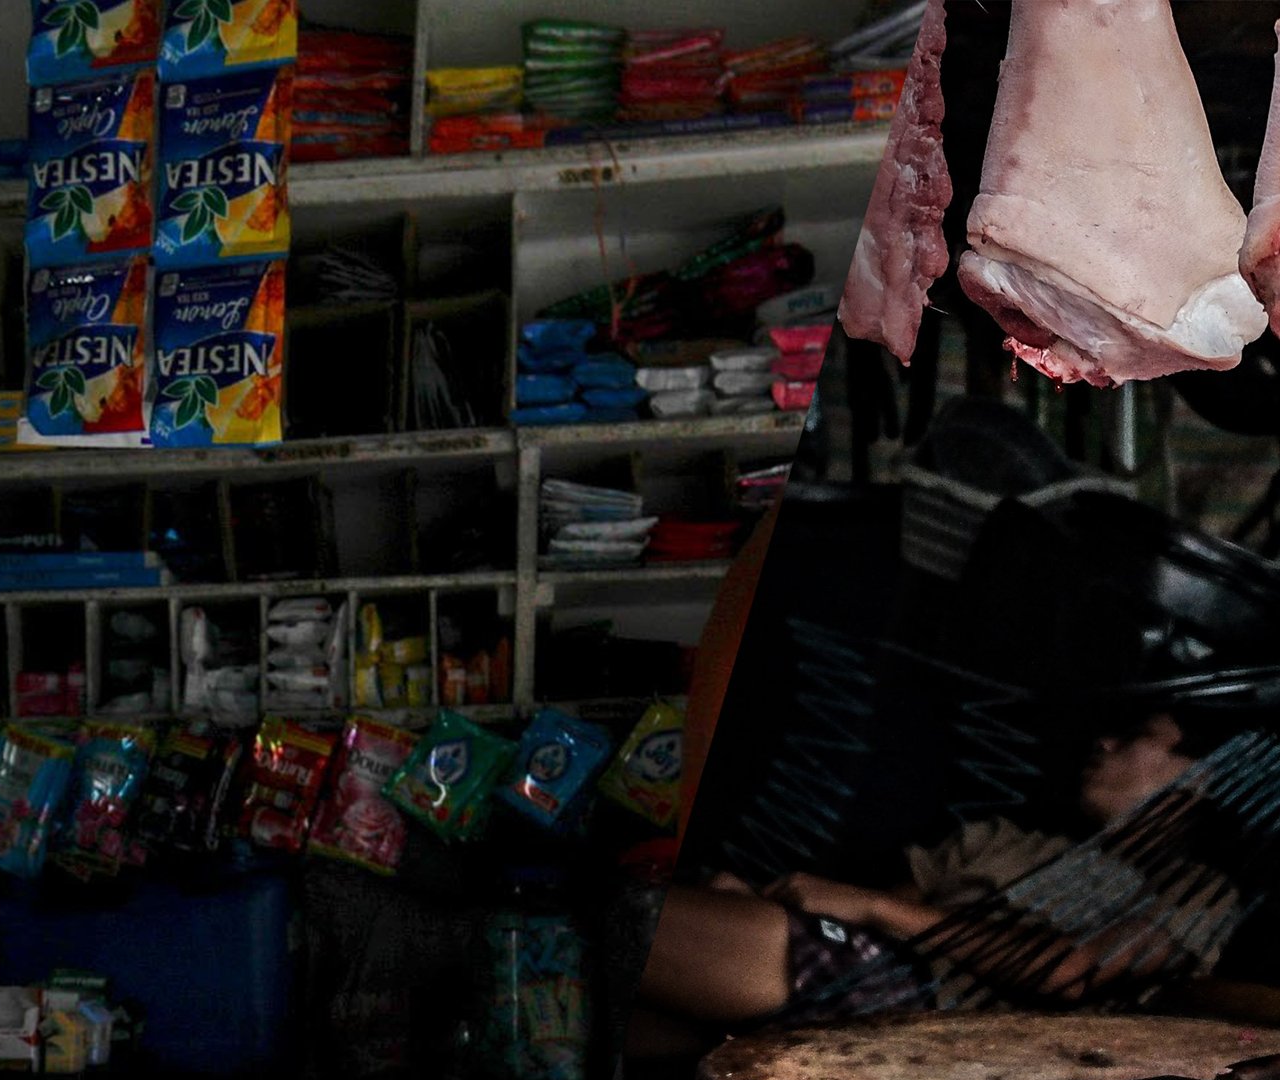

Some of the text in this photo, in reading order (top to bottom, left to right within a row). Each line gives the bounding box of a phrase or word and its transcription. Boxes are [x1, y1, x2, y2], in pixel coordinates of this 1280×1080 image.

[182, 104, 259, 140] Lemon
[32, 149, 142, 190] NESTEA
[165, 151, 279, 191] NESTEA
[172, 296, 249, 330] Lemon
[33, 333, 132, 368] NESTEA
[157, 341, 267, 377] NESTEA
[348, 748, 394, 776] Down
